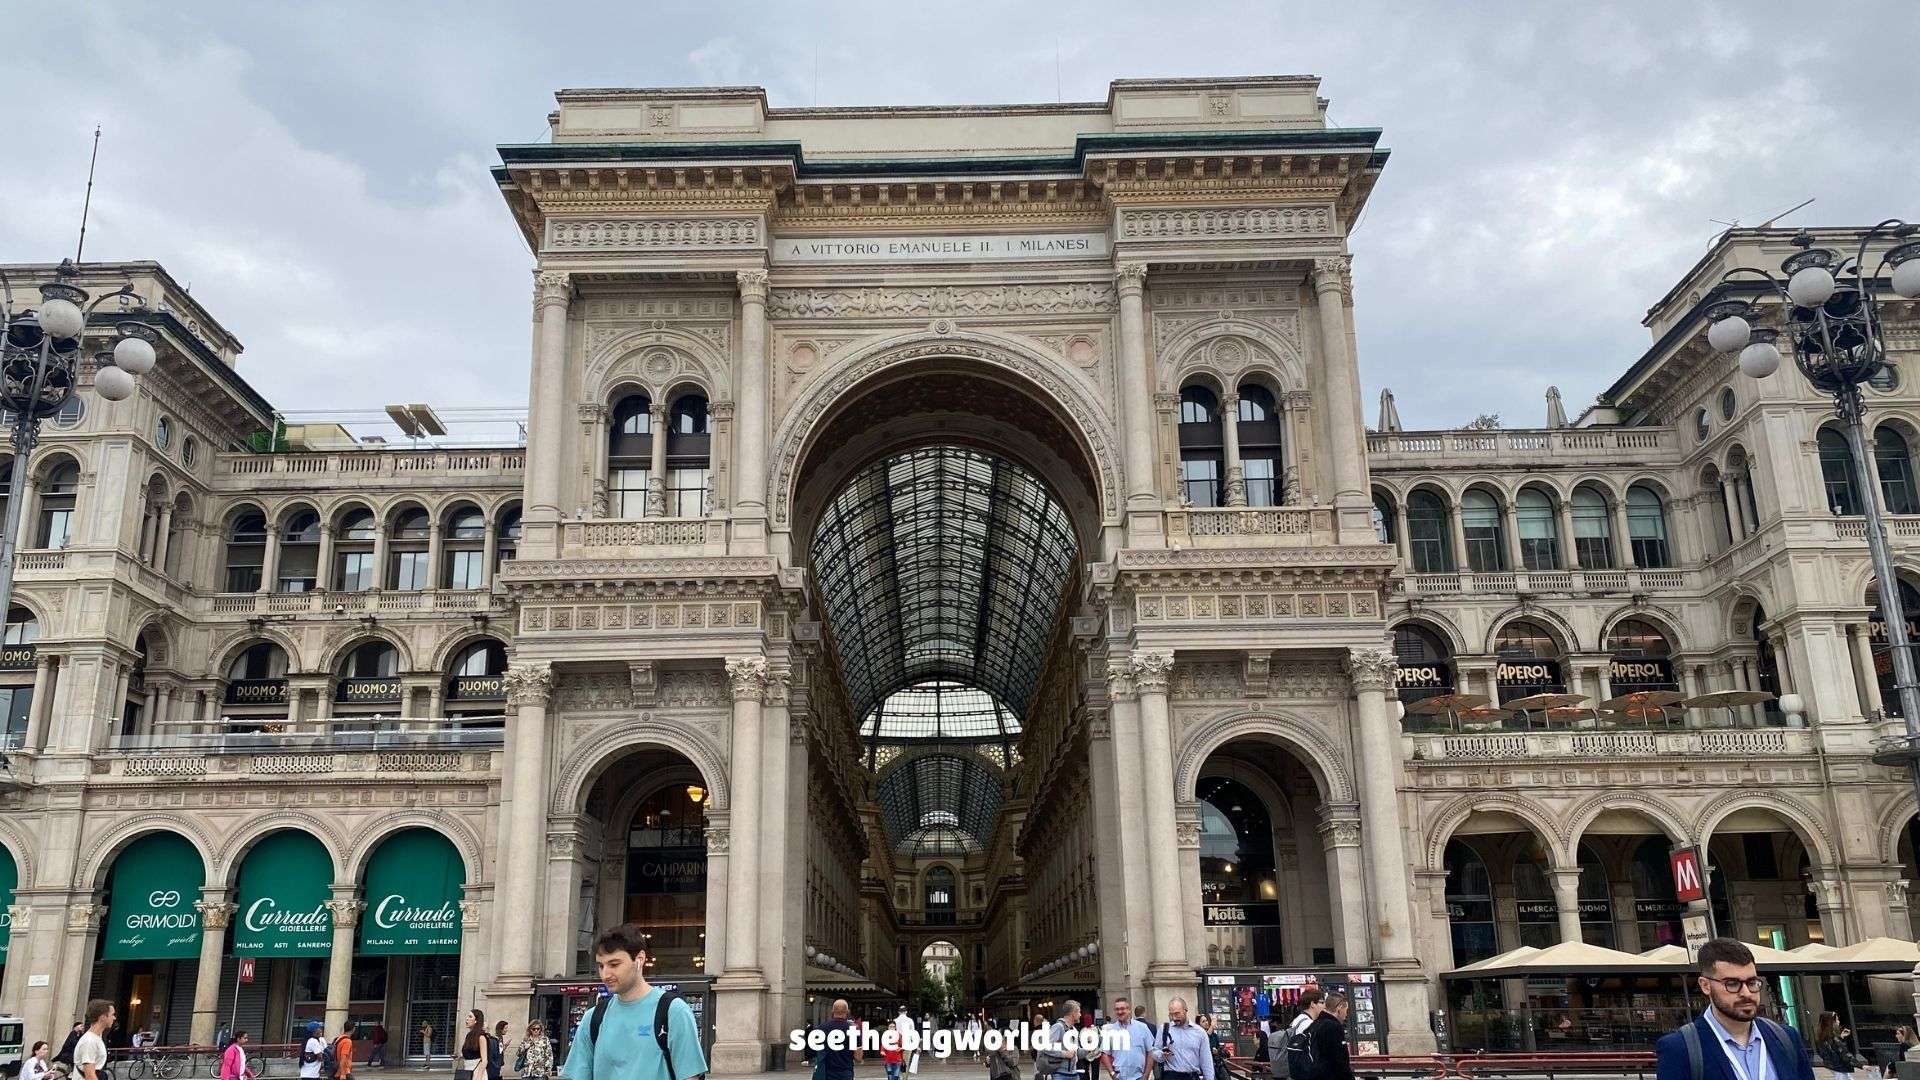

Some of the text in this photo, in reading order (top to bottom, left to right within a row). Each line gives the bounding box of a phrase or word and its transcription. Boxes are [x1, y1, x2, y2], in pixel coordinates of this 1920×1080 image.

[792, 244, 800, 254] A
[811, 243, 880, 254] VITTORIO
[889, 242, 971, 254] EMANUELE
[1019, 239, 1089, 251] MILANESI
[1868, 621, 1920, 637] PEOL
[1395, 667, 1441, 682] PEROL
[1496, 663, 1552, 680] APEROL
[1609, 661, 1664, 678] APEROL
[236, 685, 277, 696] DUOMO
[347, 683, 387, 694] DUOMO
[458, 680, 499, 691] DUOMO
[1677, 859, 1700, 892] M
[244, 897, 328, 932] Currado
[374, 894, 456, 929] Currado
[1208, 907, 1246, 921] Motta
[1528, 905, 1559, 913] MERCAT
[126, 914, 197, 929] GRIMOLDI
[297, 941, 332, 949] SANREMO
[242, 963, 253, 977] M
